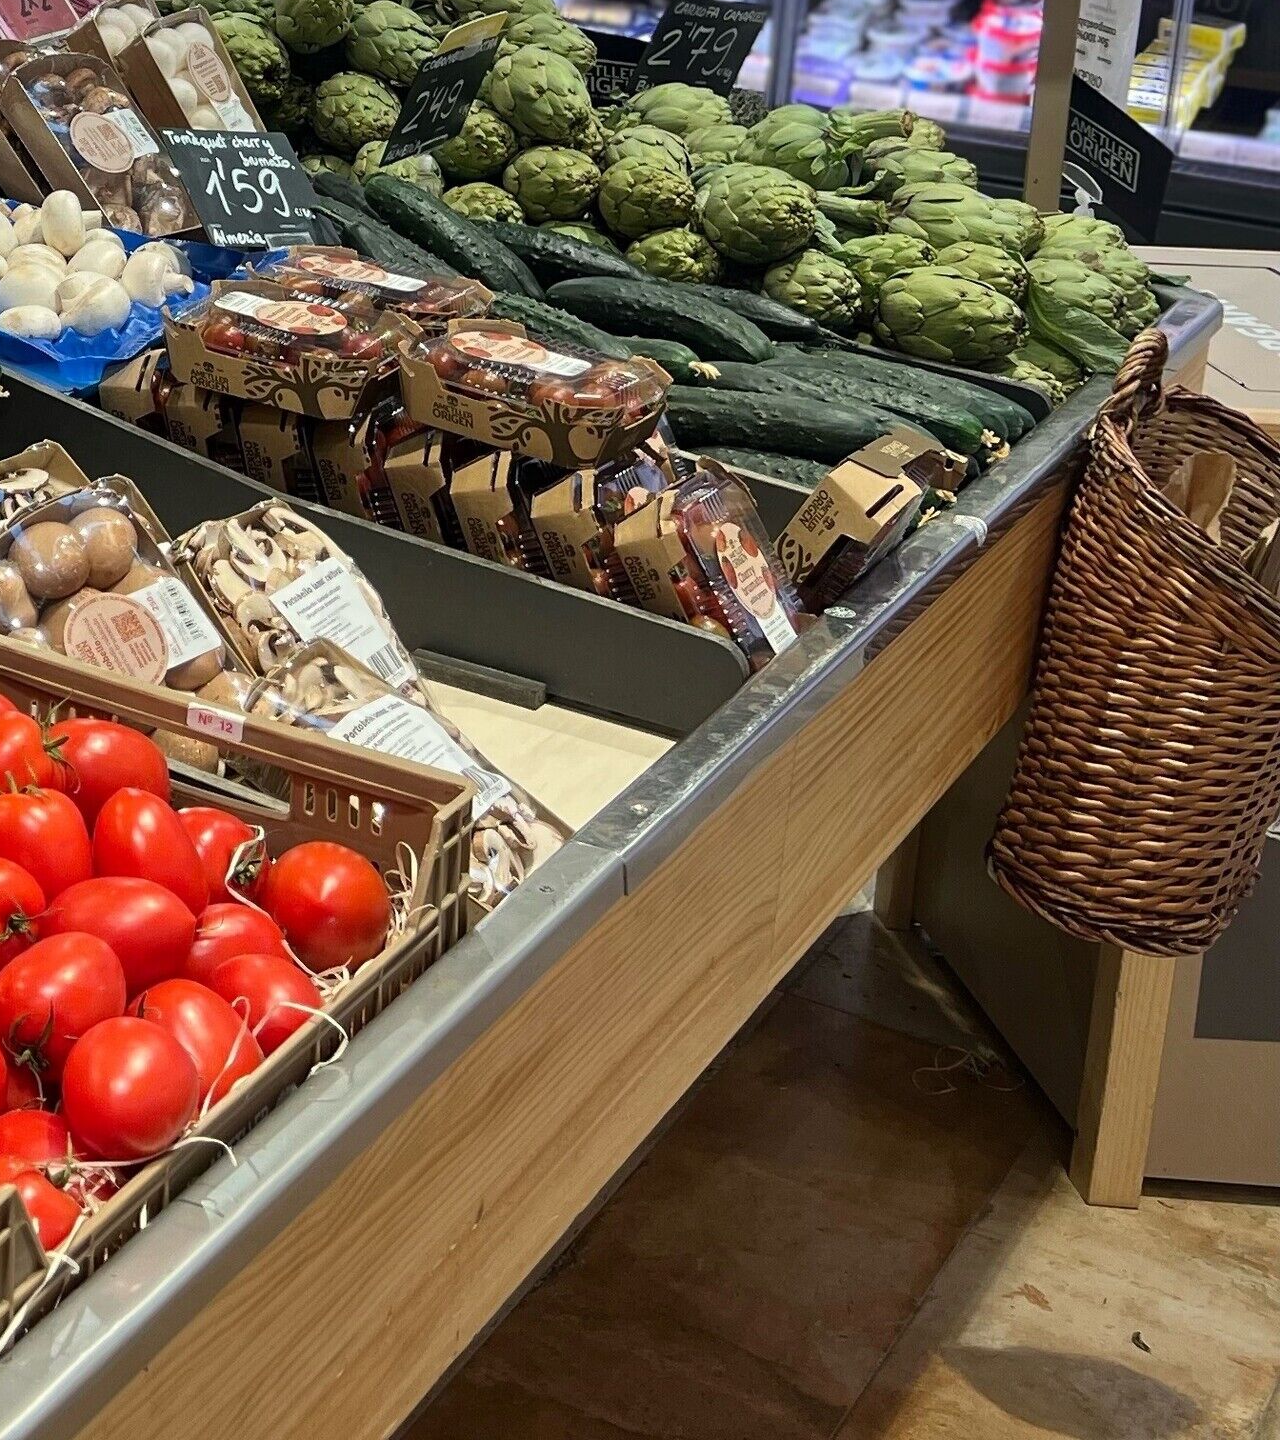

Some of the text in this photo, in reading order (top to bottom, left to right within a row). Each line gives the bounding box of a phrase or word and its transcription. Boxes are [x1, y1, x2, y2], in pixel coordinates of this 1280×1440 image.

[647, 22, 739, 77] 2'79
[401, 78, 465, 136] 2'49
[1069, 128, 1134, 185] ORIGEN
[1071, 114, 1134, 167] AMETLLER
[205, 156, 291, 219] 1'59
[191, 375, 230, 394] ORIGEN
[431, 410, 474, 429] ORIGEN
[797, 488, 830, 527] ORIGEN
[219, 719, 234, 734] 12
